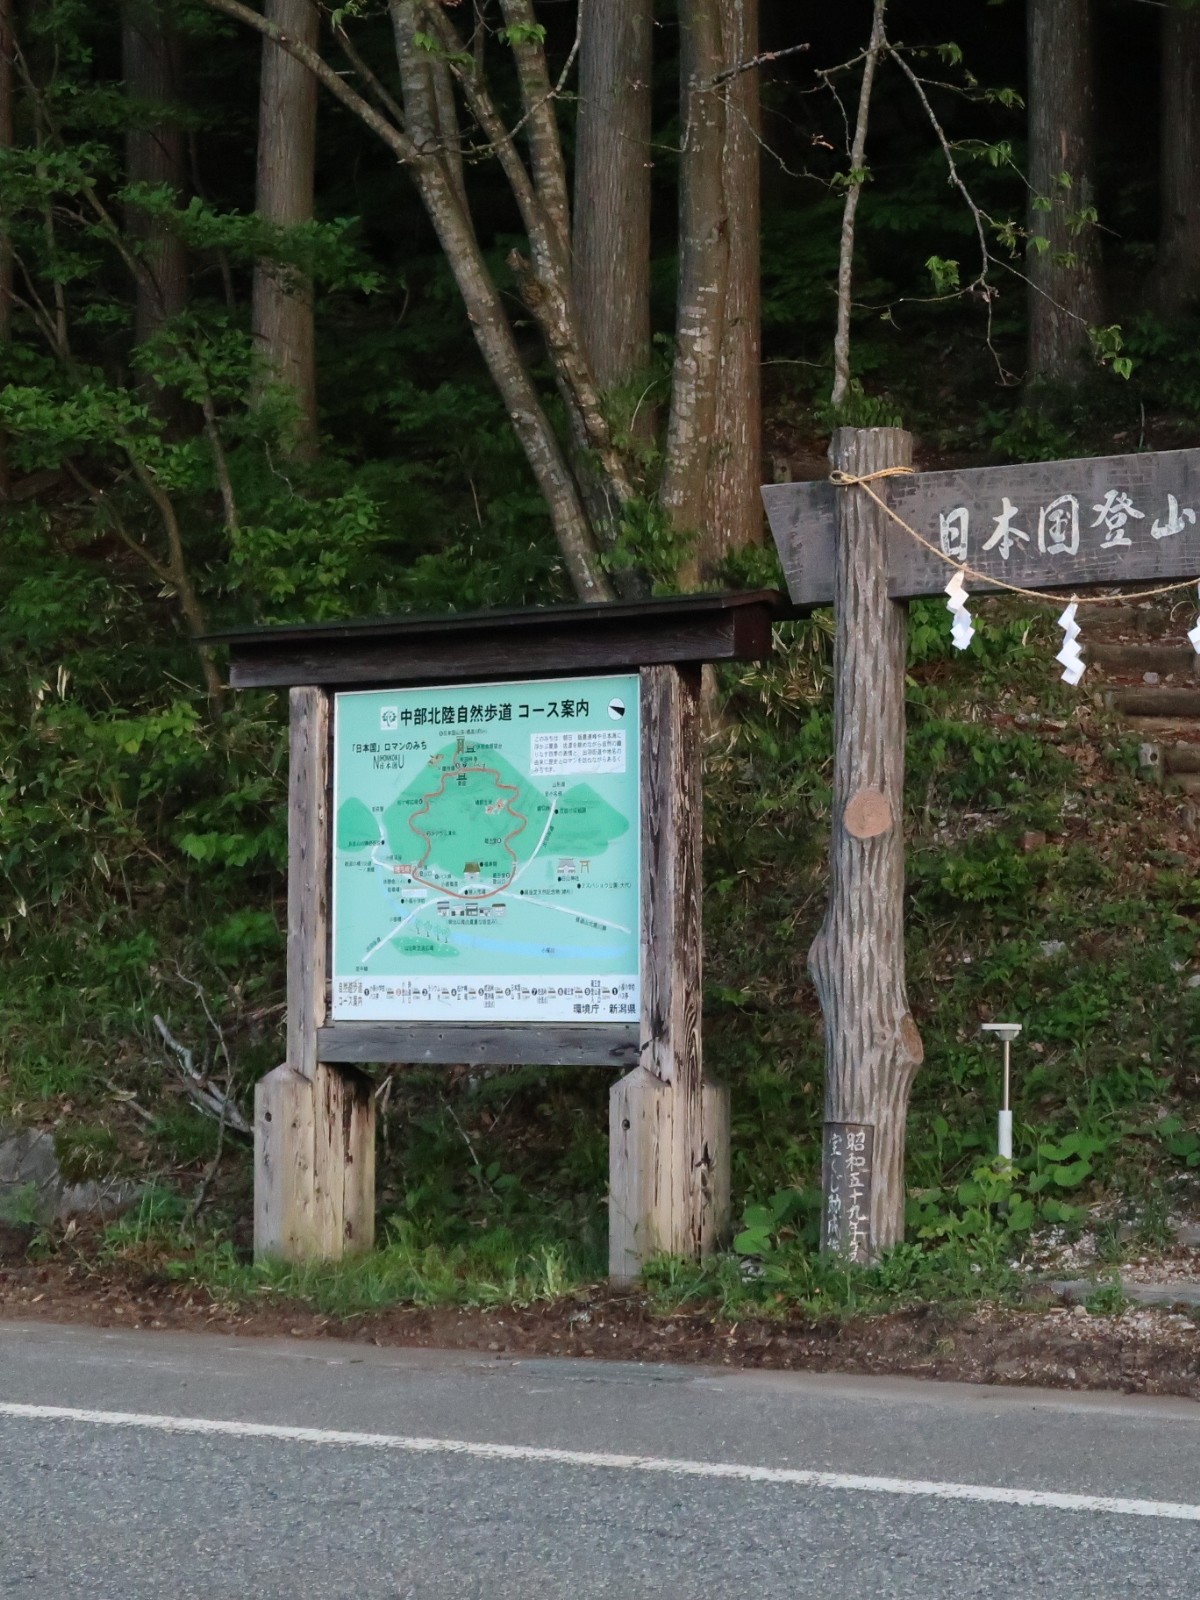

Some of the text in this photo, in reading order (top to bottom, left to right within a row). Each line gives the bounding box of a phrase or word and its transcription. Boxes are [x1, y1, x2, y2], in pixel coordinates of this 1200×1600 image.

[400, 699, 590, 727] 中部北陸自然歩道 コース案内
[384, 741, 427, 750] ロマンのみち
